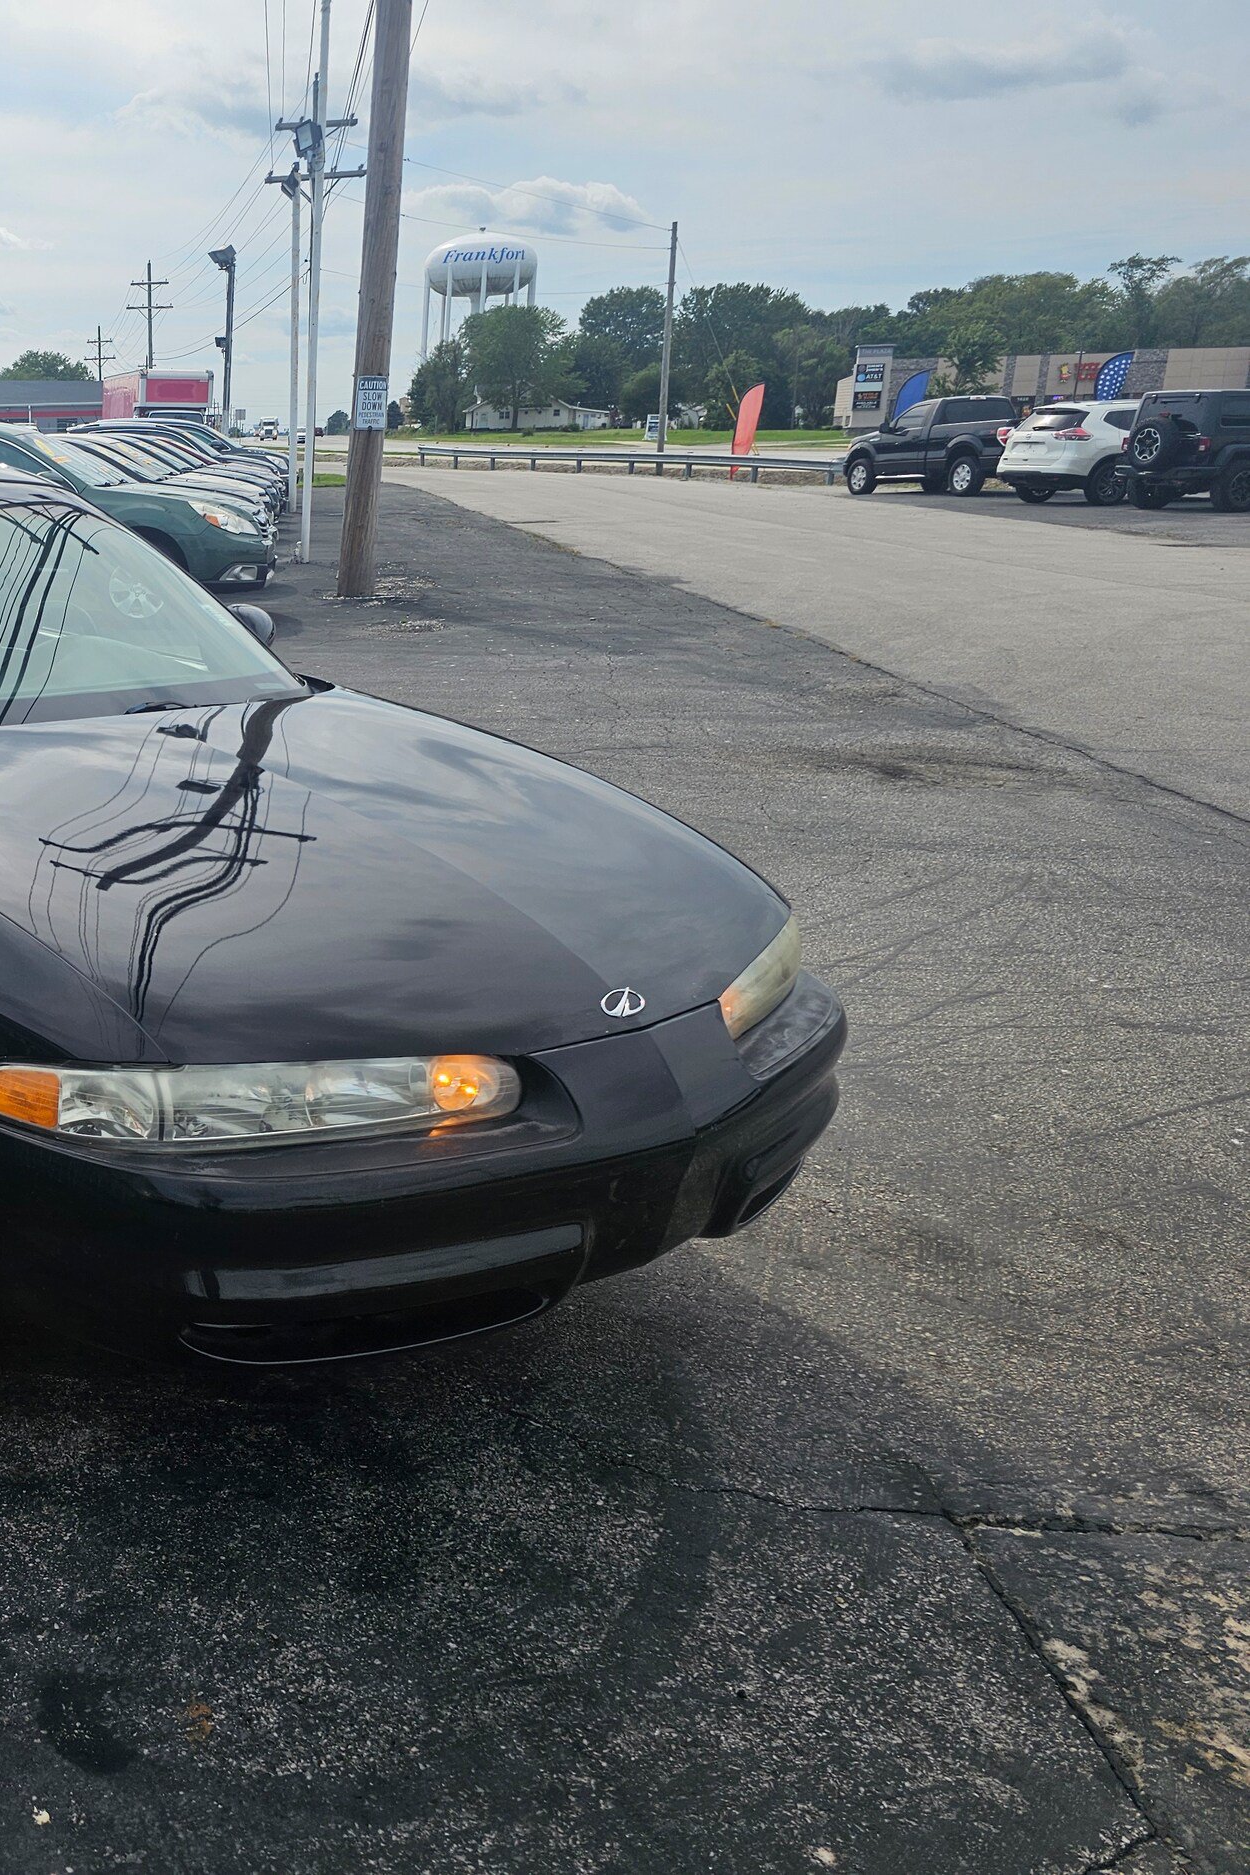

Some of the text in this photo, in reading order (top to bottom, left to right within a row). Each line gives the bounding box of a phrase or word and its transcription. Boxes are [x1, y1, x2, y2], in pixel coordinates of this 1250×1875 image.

[360, 381, 386, 389] CAUTION
[363, 392, 382, 401] SLOW
[362, 402, 382, 411] DOWN
